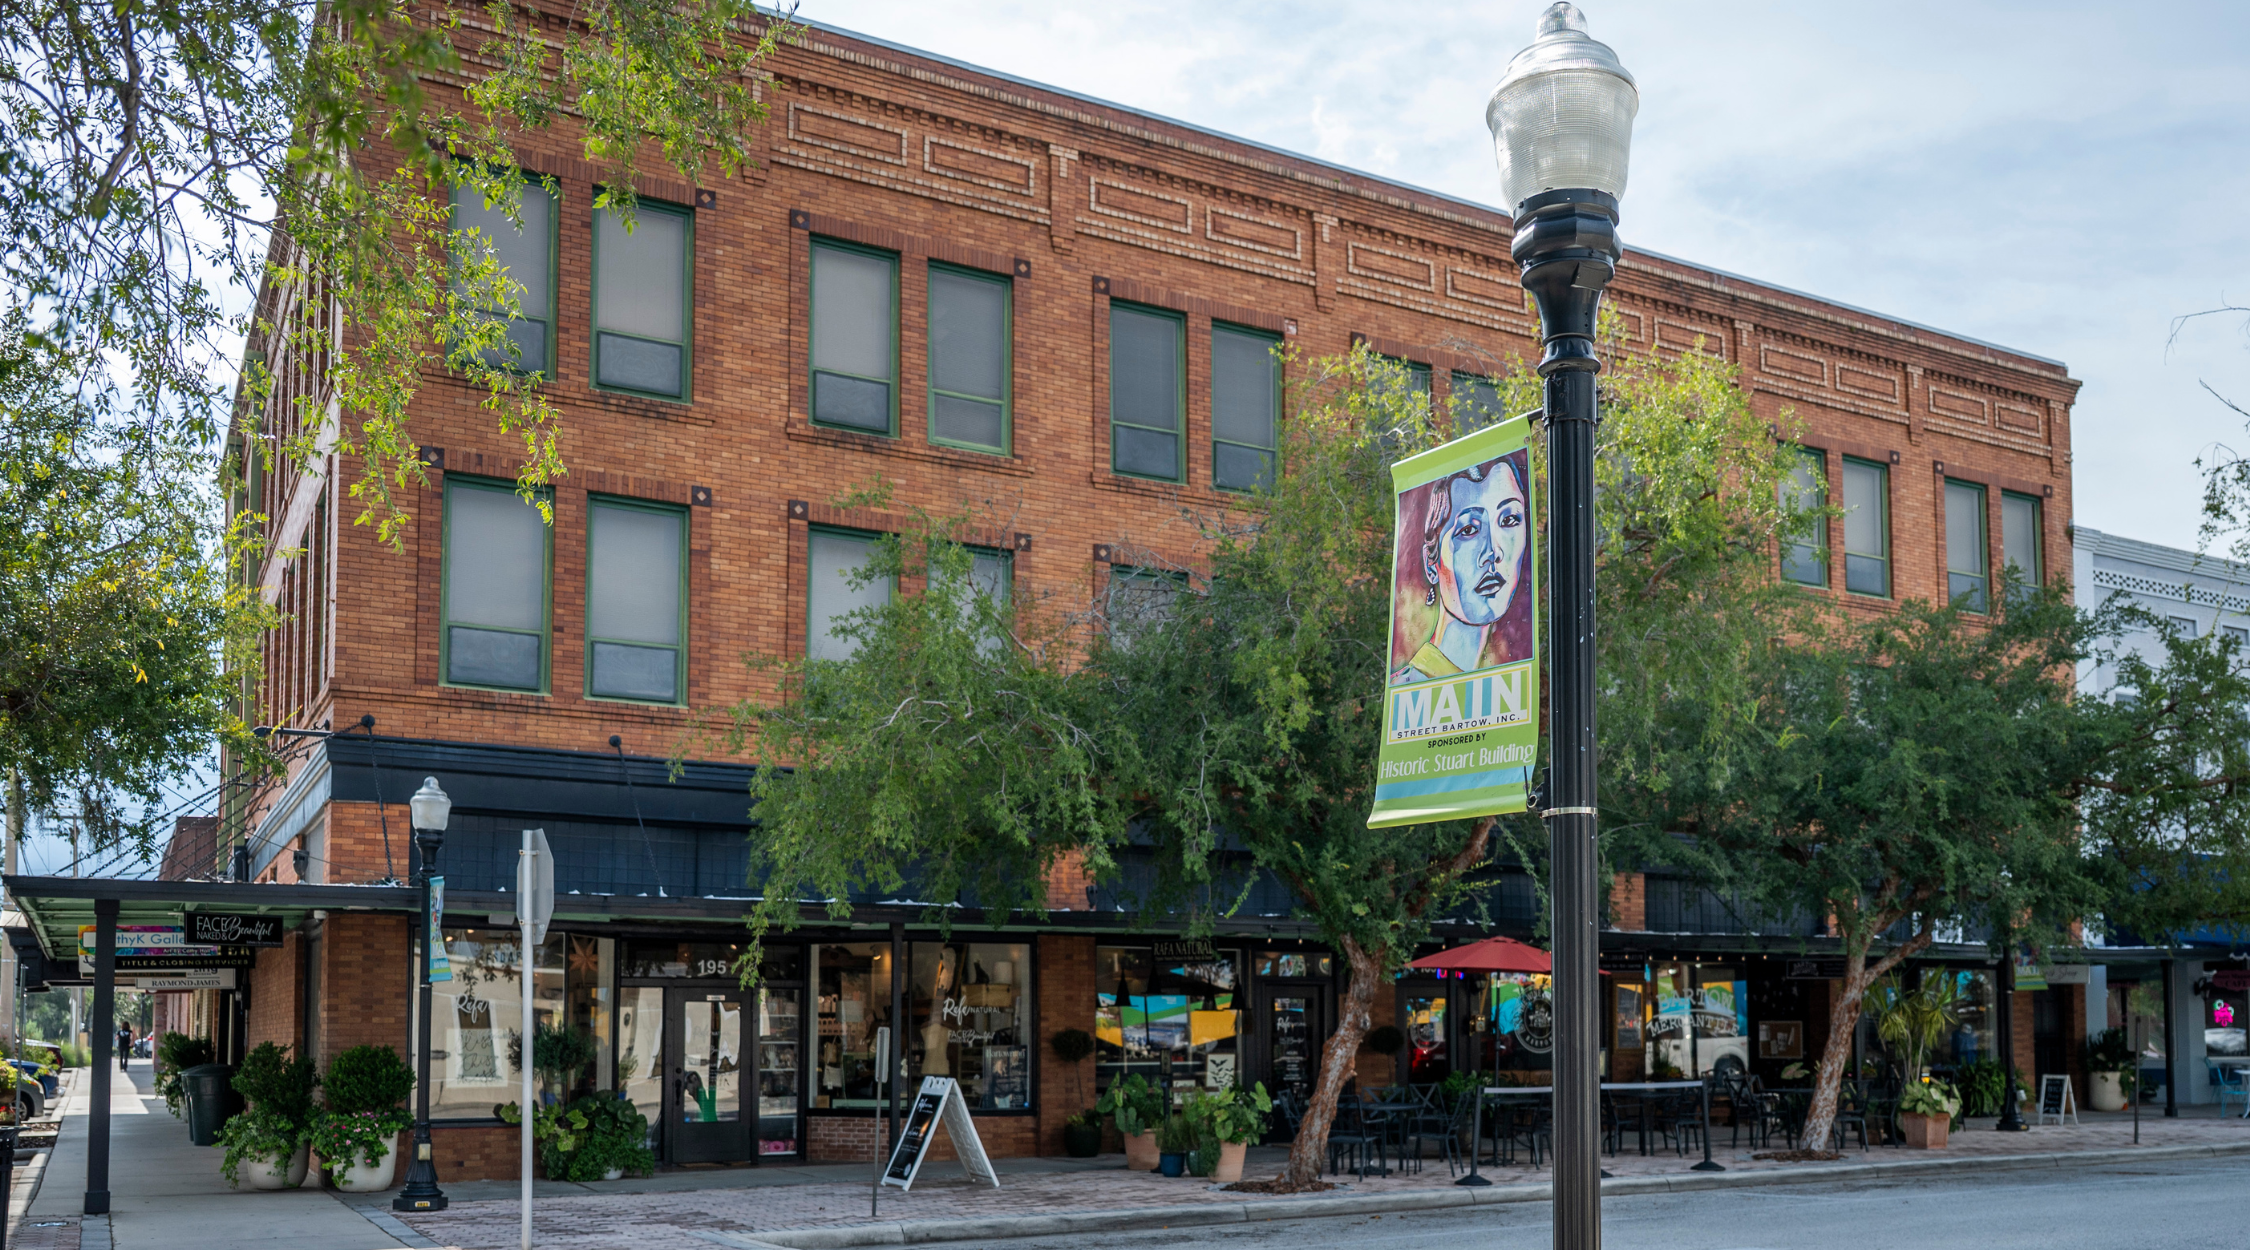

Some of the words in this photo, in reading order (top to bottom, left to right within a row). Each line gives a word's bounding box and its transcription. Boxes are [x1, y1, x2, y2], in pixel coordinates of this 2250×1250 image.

[1396, 671, 1522, 731] MAIN
[1397, 726, 1437, 739] STREET
[1442, 718, 1491, 733] BARTOW,
[1496, 714, 1520, 724] INC.
[1427, 734, 1474, 748] SPONSORED
[1475, 732, 1487, 742] BY
[1380, 756, 1430, 779] Historic
[1433, 749, 1475, 772] Stuart
[1479, 743, 1535, 763] Building
[196, 916, 228, 932] FACE
[225, 915, 274, 941] Beautiful
[196, 931, 222, 940] NAKED
[1154, 942, 1174, 956] RAFA
[203, 958, 249, 966] SERVICES
[698, 960, 727, 974] 195
[194, 979, 221, 987] JAMES
[456, 992, 491, 1024] Rafa
[943, 995, 970, 1026] Rafa
[970, 1006, 1001, 1014] NATURAL
[1650, 1013, 1741, 1038] MERCANTILE
